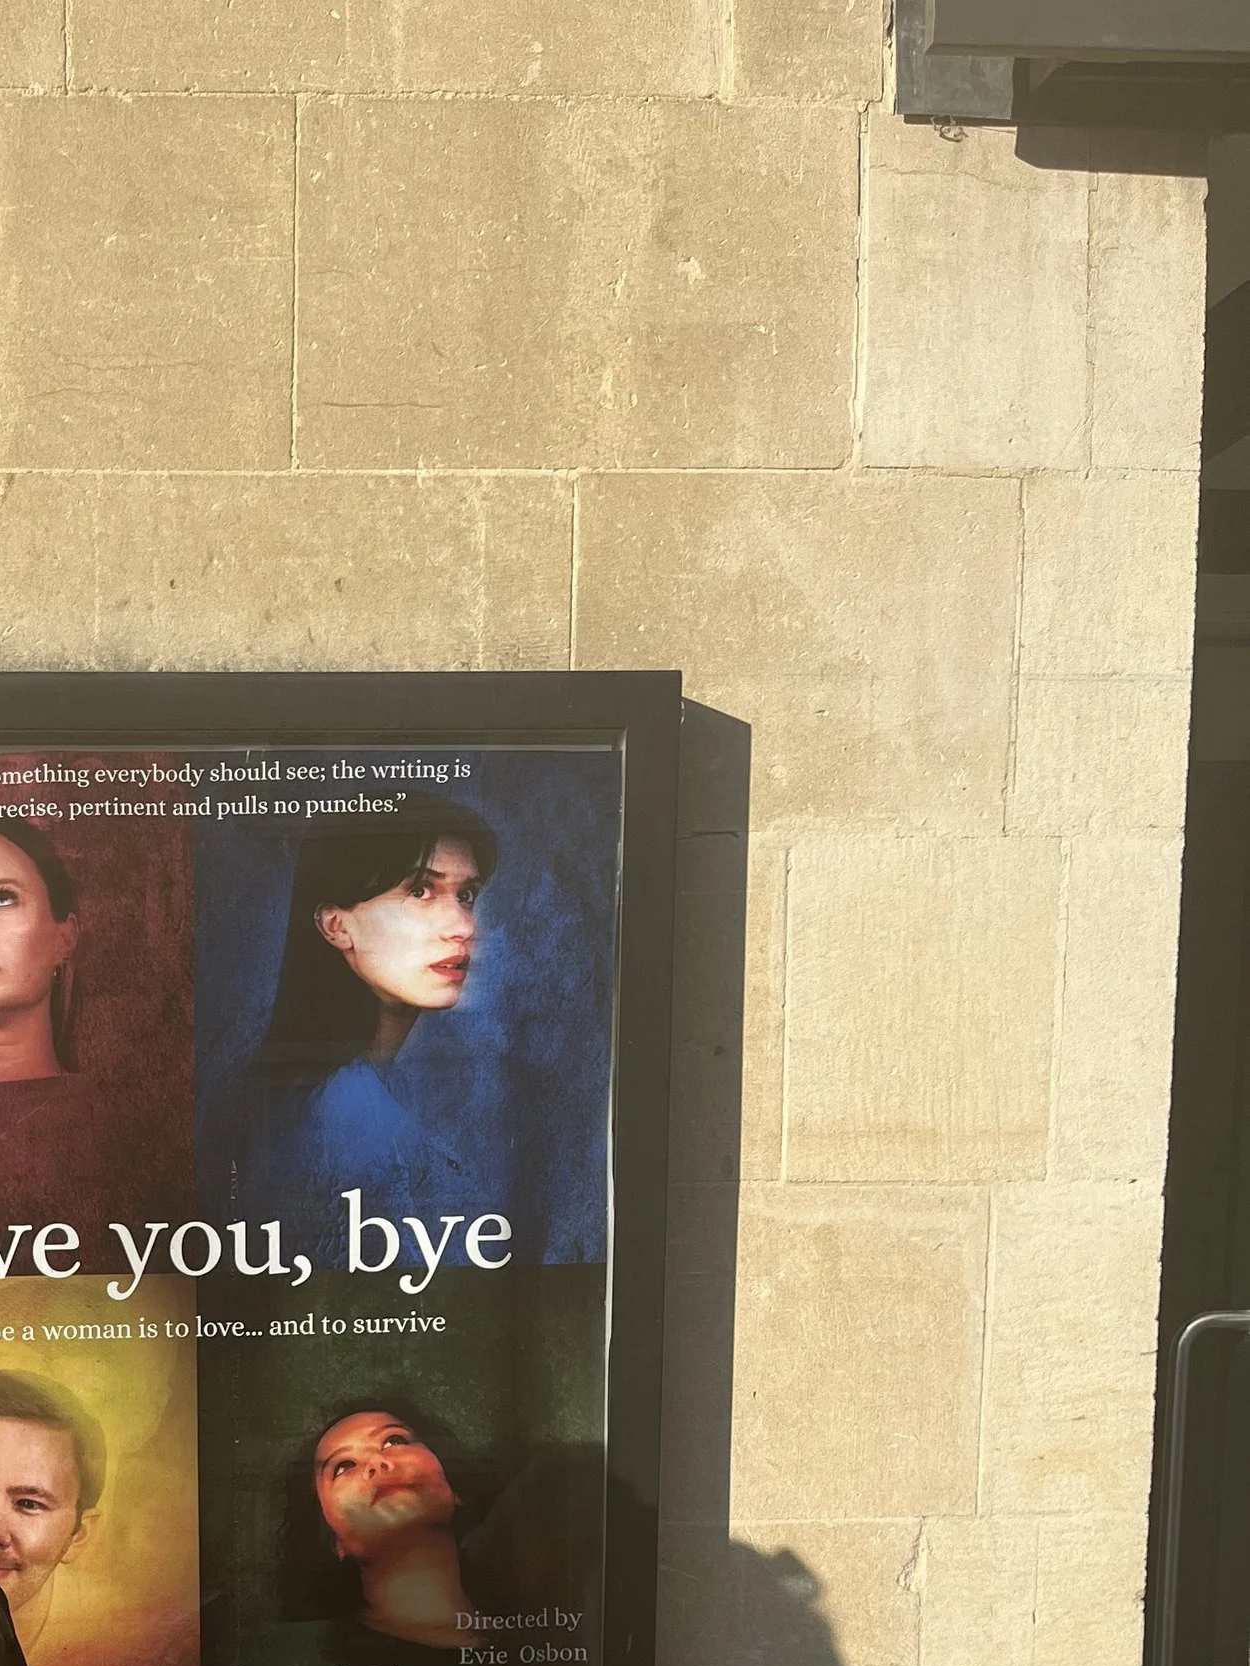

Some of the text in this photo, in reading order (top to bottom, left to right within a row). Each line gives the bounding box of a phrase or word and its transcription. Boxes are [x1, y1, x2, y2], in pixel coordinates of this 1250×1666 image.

[94, 762, 205, 788] everybody
[209, 761, 281, 782] should
[286, 765, 326, 783] see;
[332, 759, 366, 780] the
[371, 759, 449, 784] writing
[453, 758, 471, 779] is
[68, 796, 168, 821] pertinent
[172, 796, 212, 817] and
[216, 795, 268, 820] pulls
[273, 799, 301, 815] no
[304, 792, 407, 819] punches.”
[106, 1218, 313, 1301] you,
[340, 1187, 514, 1296] bye
[21, 1326, 36, 1342] a
[41, 1323, 133, 1341] woman
[138, 1317, 158, 1340] is
[164, 1319, 190, 1340] to
[195, 1315, 264, 1338] love...
[268, 1313, 315, 1338] and
[320, 1315, 347, 1336] to
[352, 1312, 447, 1335] survive
[455, 1606, 583, 1632] Directed by
[458, 1642, 588, 1665] Evie Osbon
